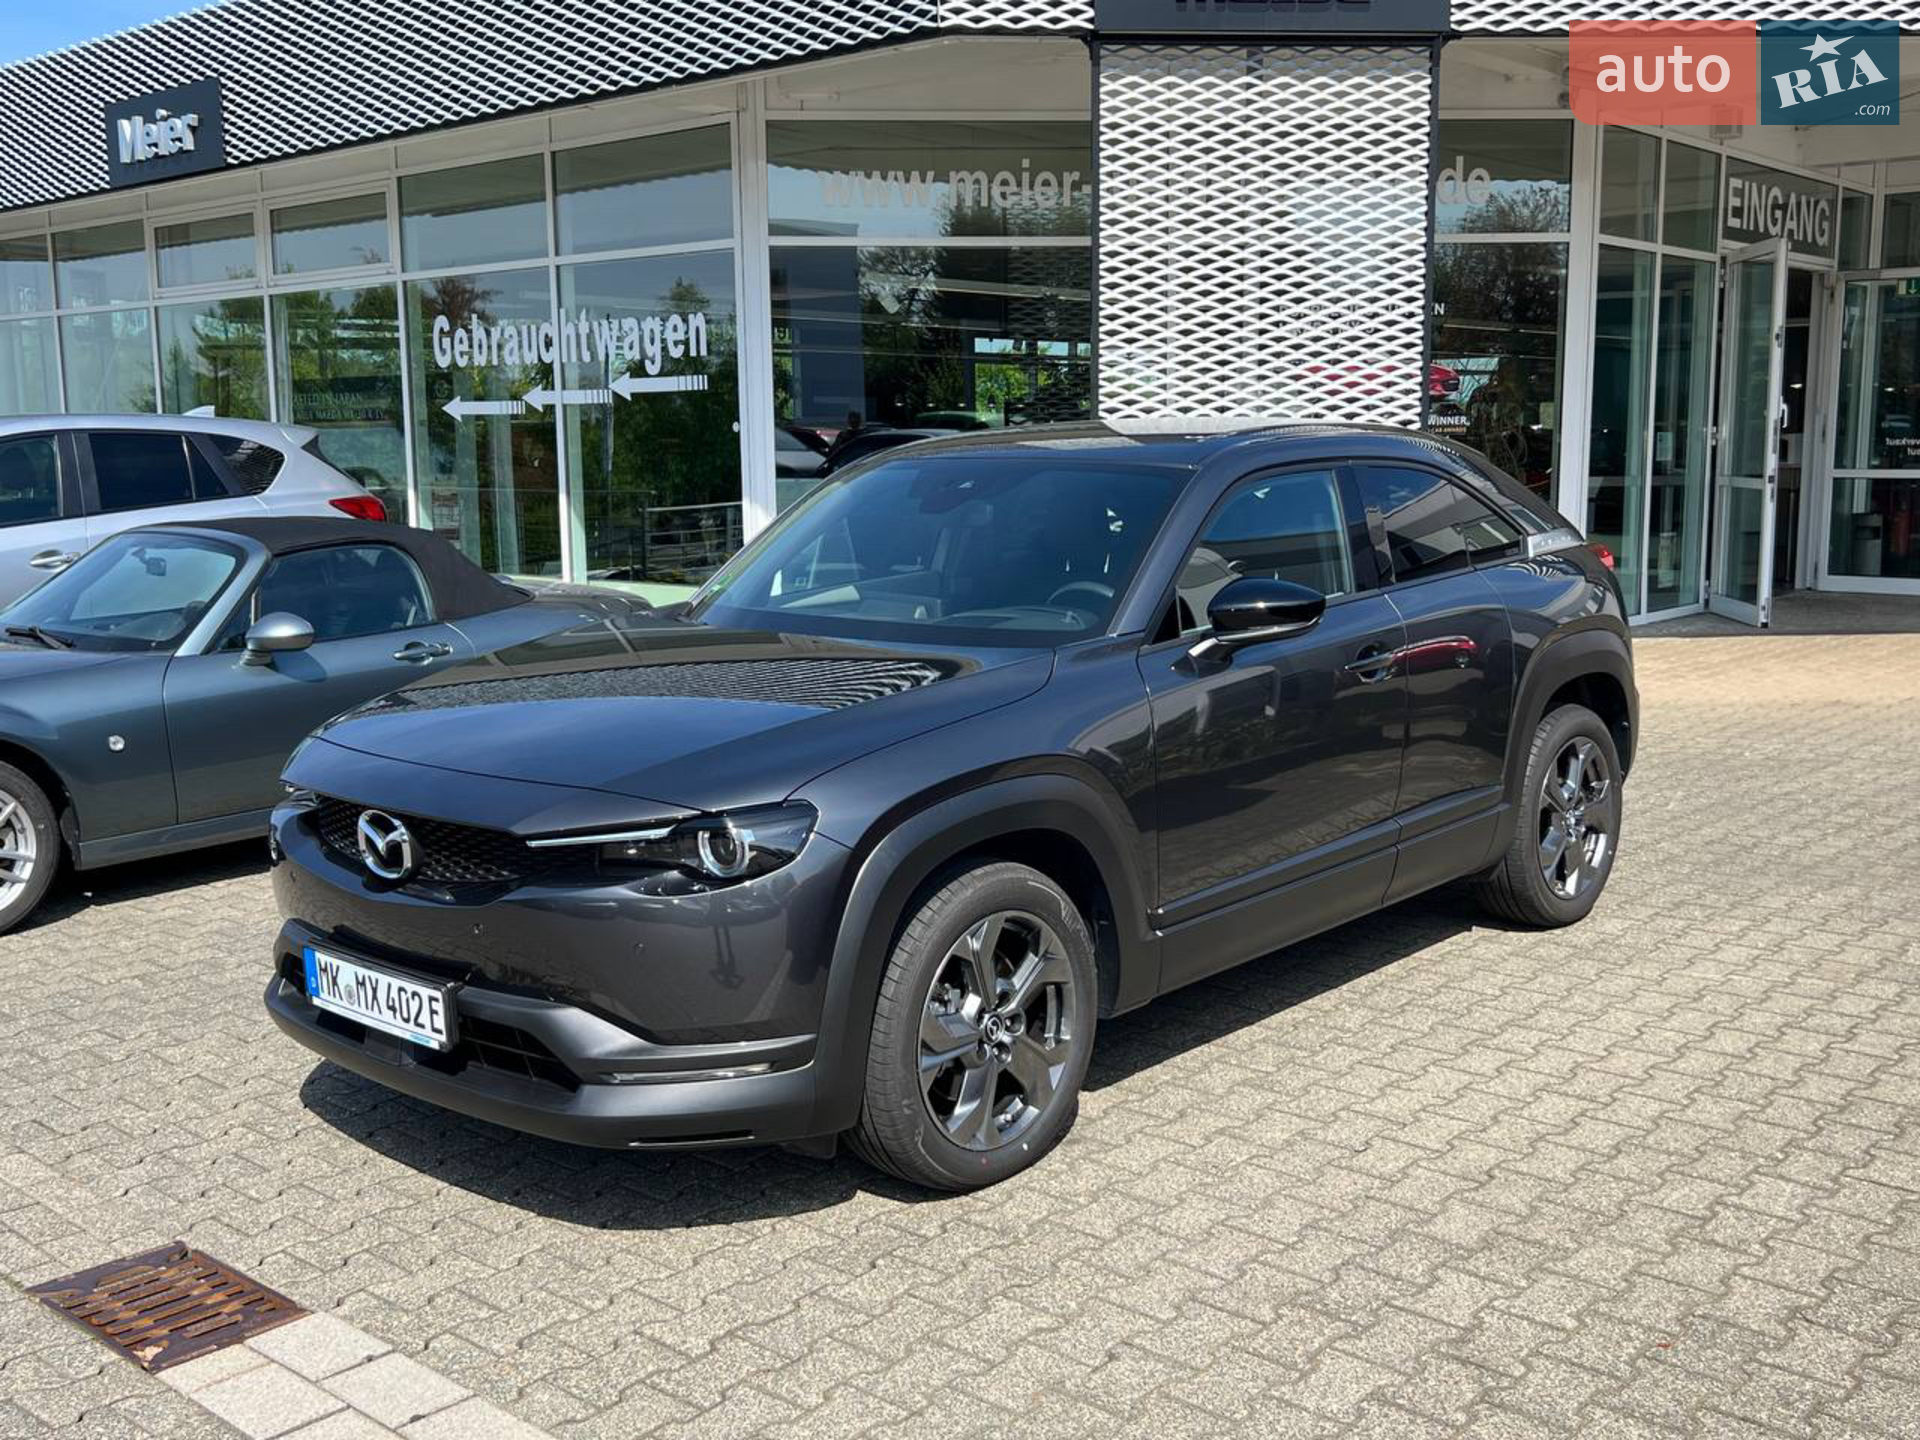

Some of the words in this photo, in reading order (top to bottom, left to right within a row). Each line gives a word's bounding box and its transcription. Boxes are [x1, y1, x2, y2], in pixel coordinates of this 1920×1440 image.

[117, 108, 198, 163] Meier
[1727, 177, 1830, 247] EINGANG
[433, 307, 708, 376] Gebrauchtwagen
[317, 957, 344, 1001] MK
[354, 971, 382, 1015] MX
[386, 981, 443, 1035] 402E
